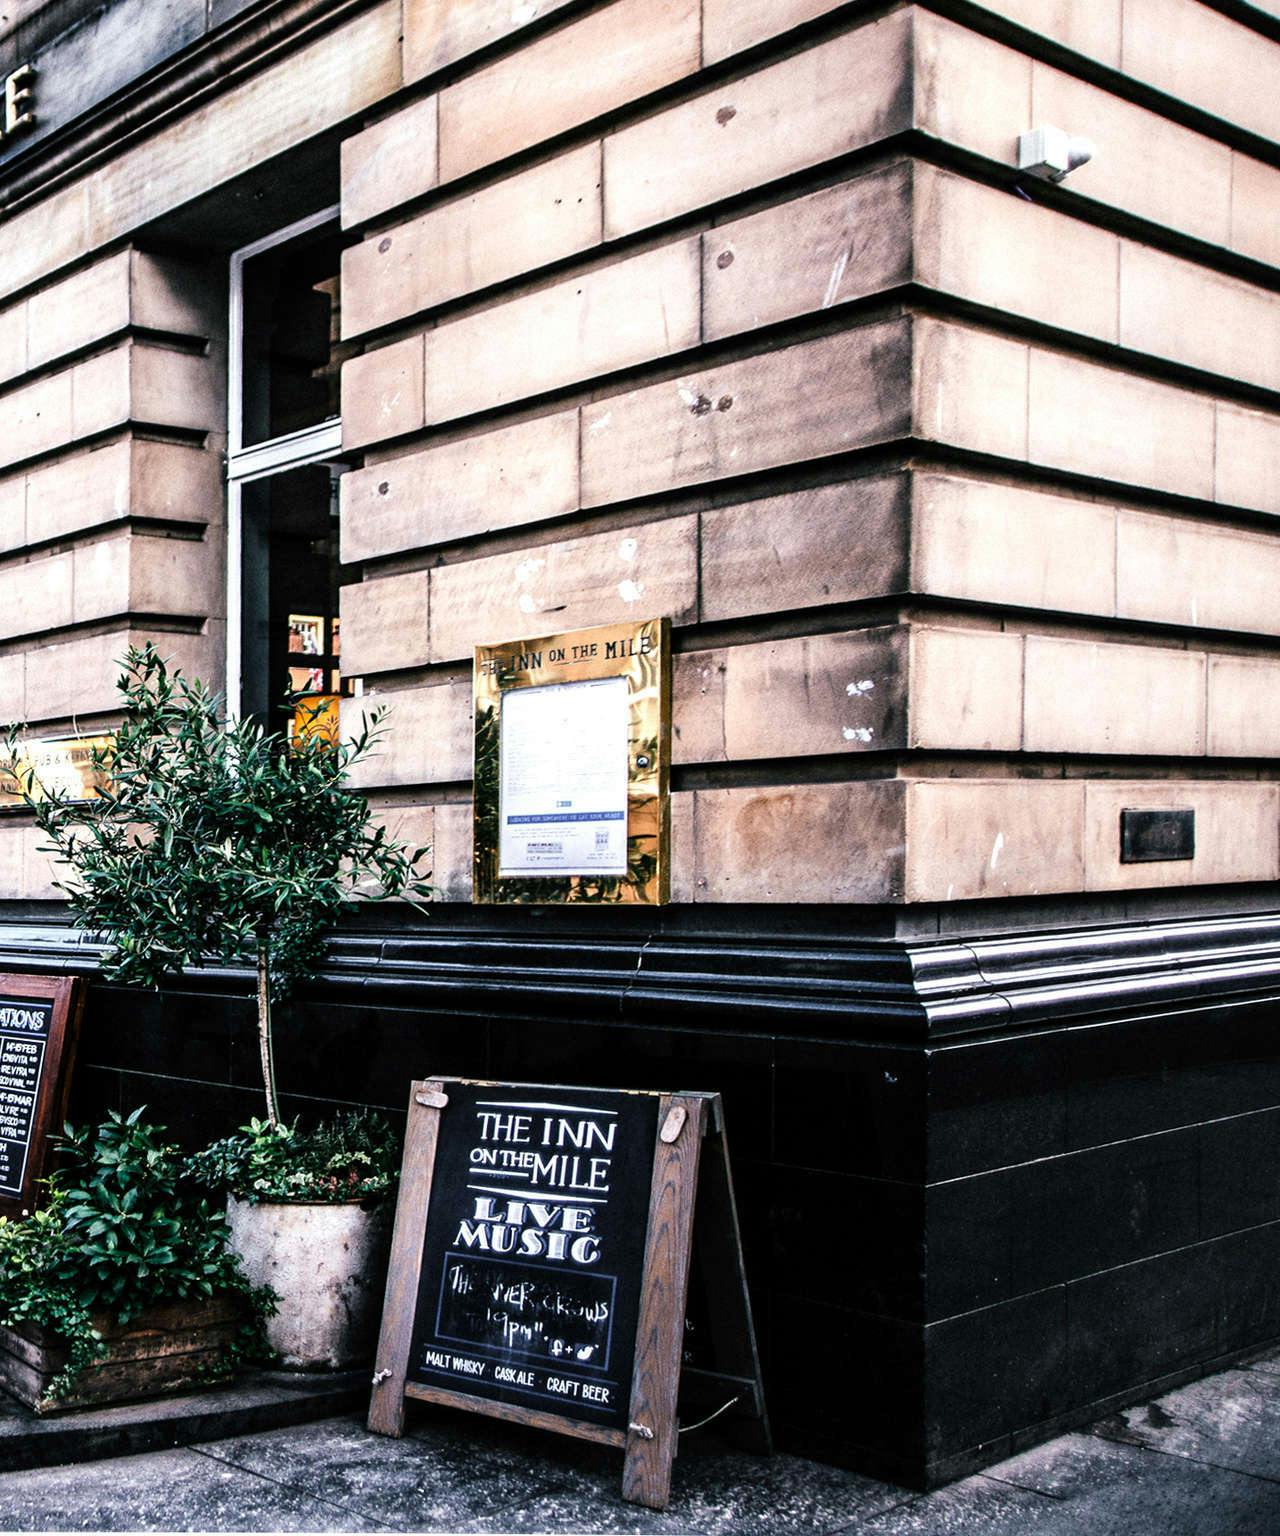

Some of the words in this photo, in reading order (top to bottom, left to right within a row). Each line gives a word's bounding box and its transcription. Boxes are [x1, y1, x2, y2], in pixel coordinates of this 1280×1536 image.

[510, 652, 542, 672] INN
[549, 648, 566, 662] ON
[571, 643, 598, 659] THE
[604, 636, 651, 660] MILE
[476, 1112, 532, 1144] THE
[541, 1117, 618, 1151] INN
[469, 1148, 498, 1166] ON
[499, 1151, 535, 1169] THE
[530, 1153, 612, 1192] MILE
[473, 1196, 596, 1234] LIVE
[453, 1220, 603, 1265] MUSIC
[425, 1351, 452, 1369] MALT
[452, 1356, 485, 1377] WHISKY
[494, 1366, 516, 1384] CASK
[515, 1371, 535, 1387] ALE
[546, 1376, 580, 1399] CRAFT
[582, 1384, 610, 1404] BEER
